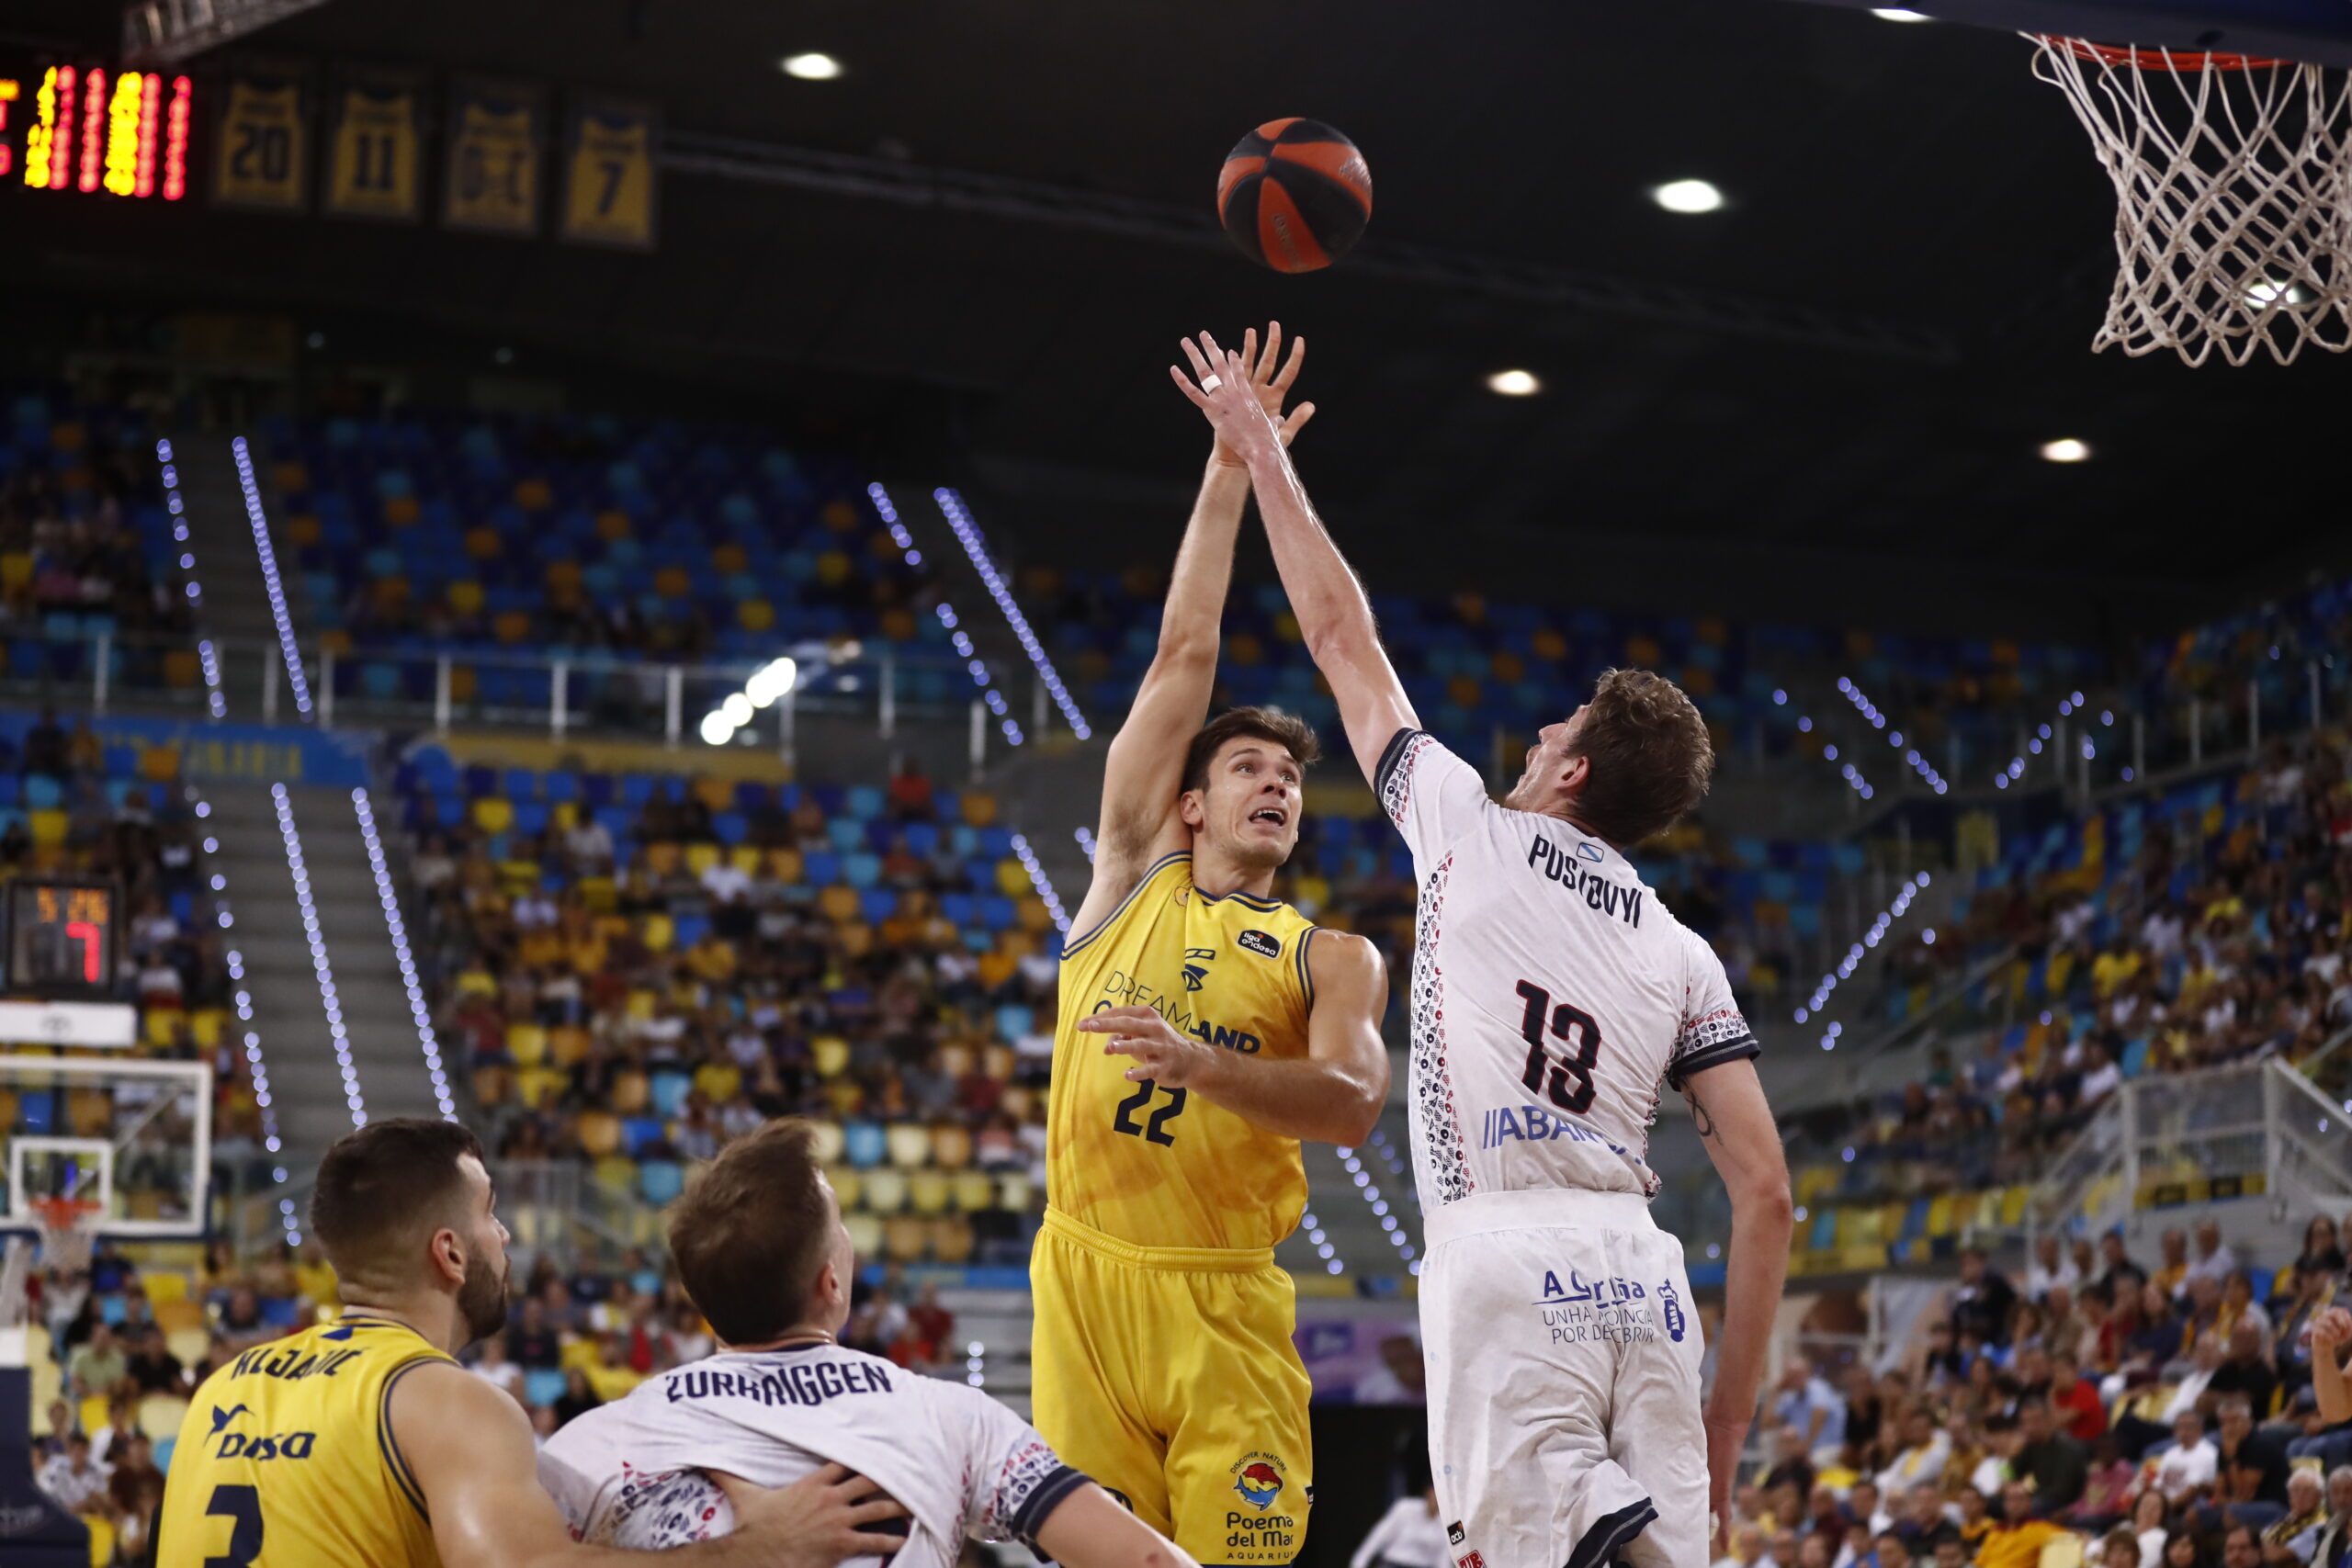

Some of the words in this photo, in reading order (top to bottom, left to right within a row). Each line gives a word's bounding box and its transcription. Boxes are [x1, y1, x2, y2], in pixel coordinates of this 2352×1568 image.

[233, 123, 289, 182] 20
[1243, 931, 1261, 942] liga
[65, 921, 100, 984] 7
[1241, 938, 1276, 956] endesa
[1516, 979, 1601, 1115] 13
[1113, 1066, 1187, 1148] 22
[1544, 1270, 1565, 1298] A
[1544, 1306, 1593, 1326] UNHA
[1552, 1325, 1588, 1345] POR
[1229, 1451, 1259, 1473] DISCOVER
[203, 1484, 264, 1568] 3
[1227, 1512, 1294, 1529] Poema
[1227, 1531, 1255, 1547] del
[1263, 1530, 1294, 1547] Mar
[1451, 1530, 1463, 1543] acb
[1227, 1551, 1294, 1560] AQUARIU
